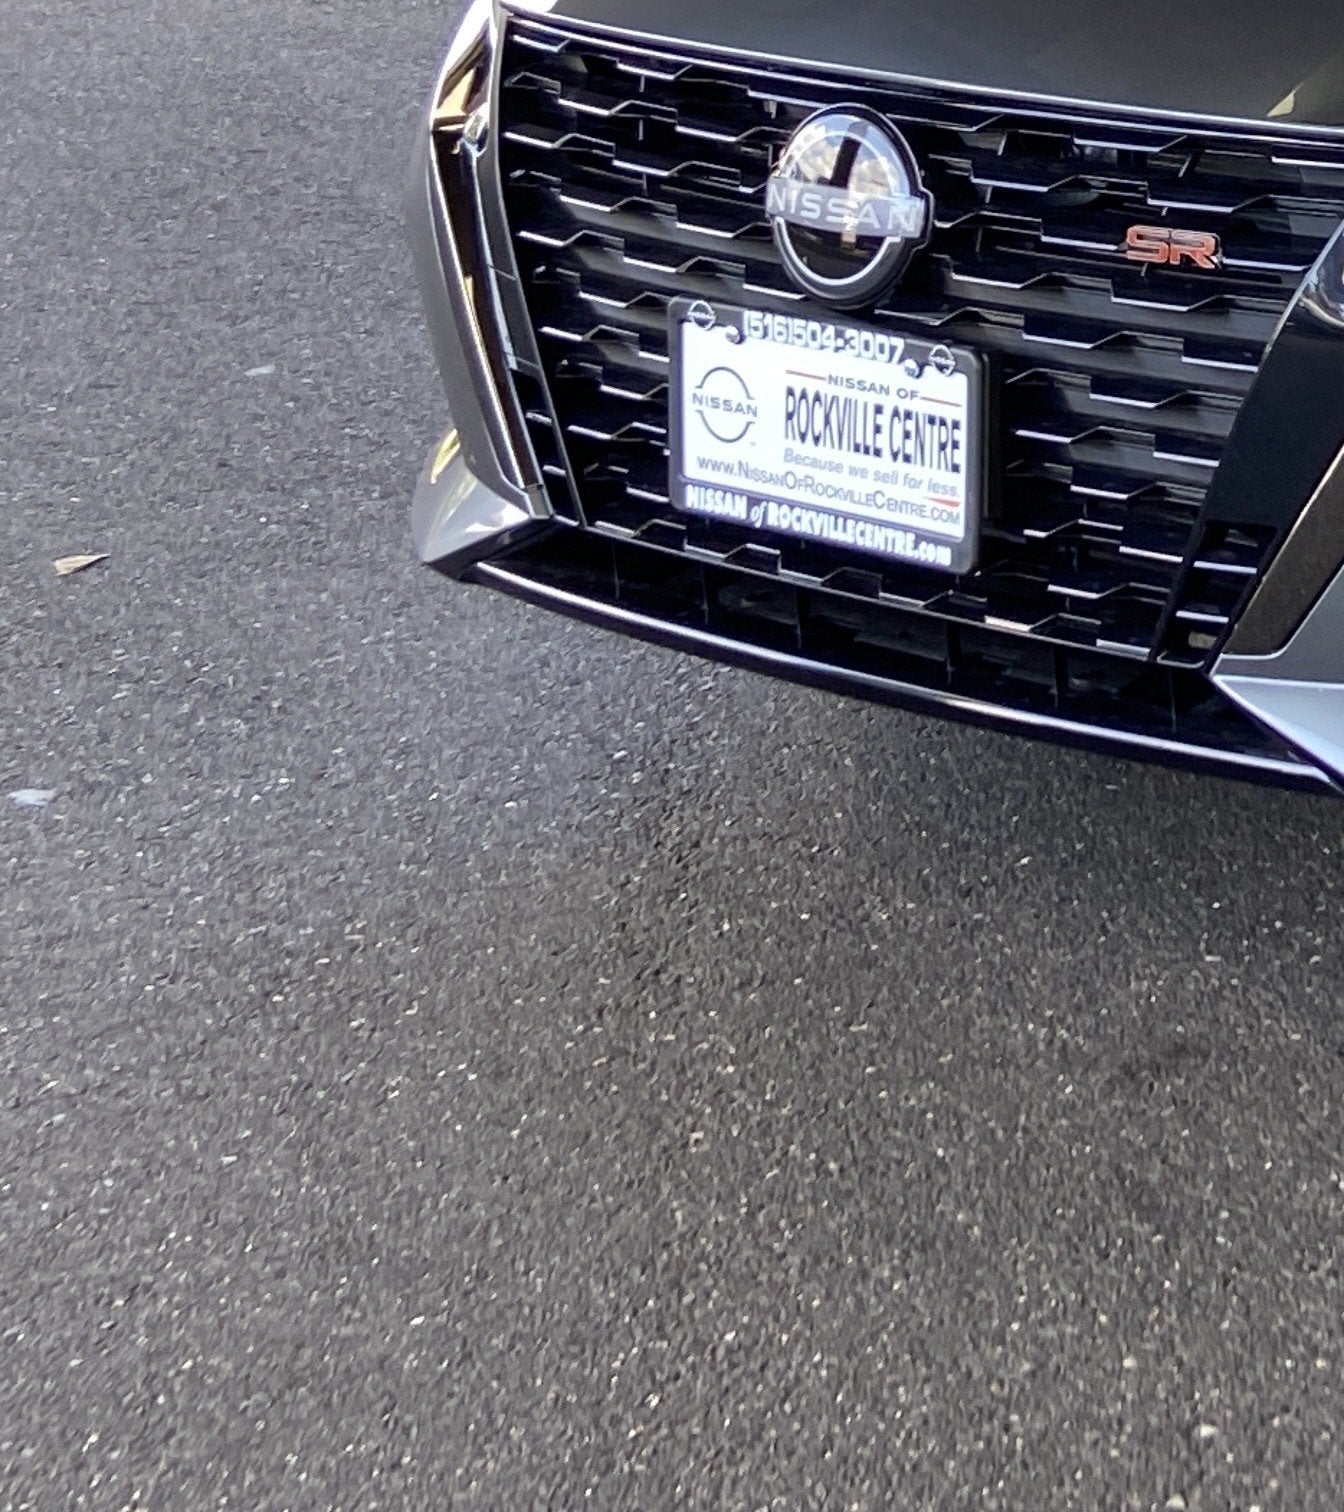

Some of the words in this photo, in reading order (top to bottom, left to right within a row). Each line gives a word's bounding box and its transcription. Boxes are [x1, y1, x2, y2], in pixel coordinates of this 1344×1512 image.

[767, 182, 920, 233] NISSAN
[1126, 224, 1218, 270] SR
[691, 391, 758, 418] NISSAN
[826, 373, 891, 396] NISSAN
[895, 387, 921, 401] OF
[784, 385, 884, 459] ROCKVILLE
[888, 404, 962, 474] CENTRE
[783, 447, 844, 474] Because
[848, 464, 870, 480] we
[873, 469, 899, 486] sell
[902, 472, 925, 490] for
[686, 484, 747, 520] NISSAN
